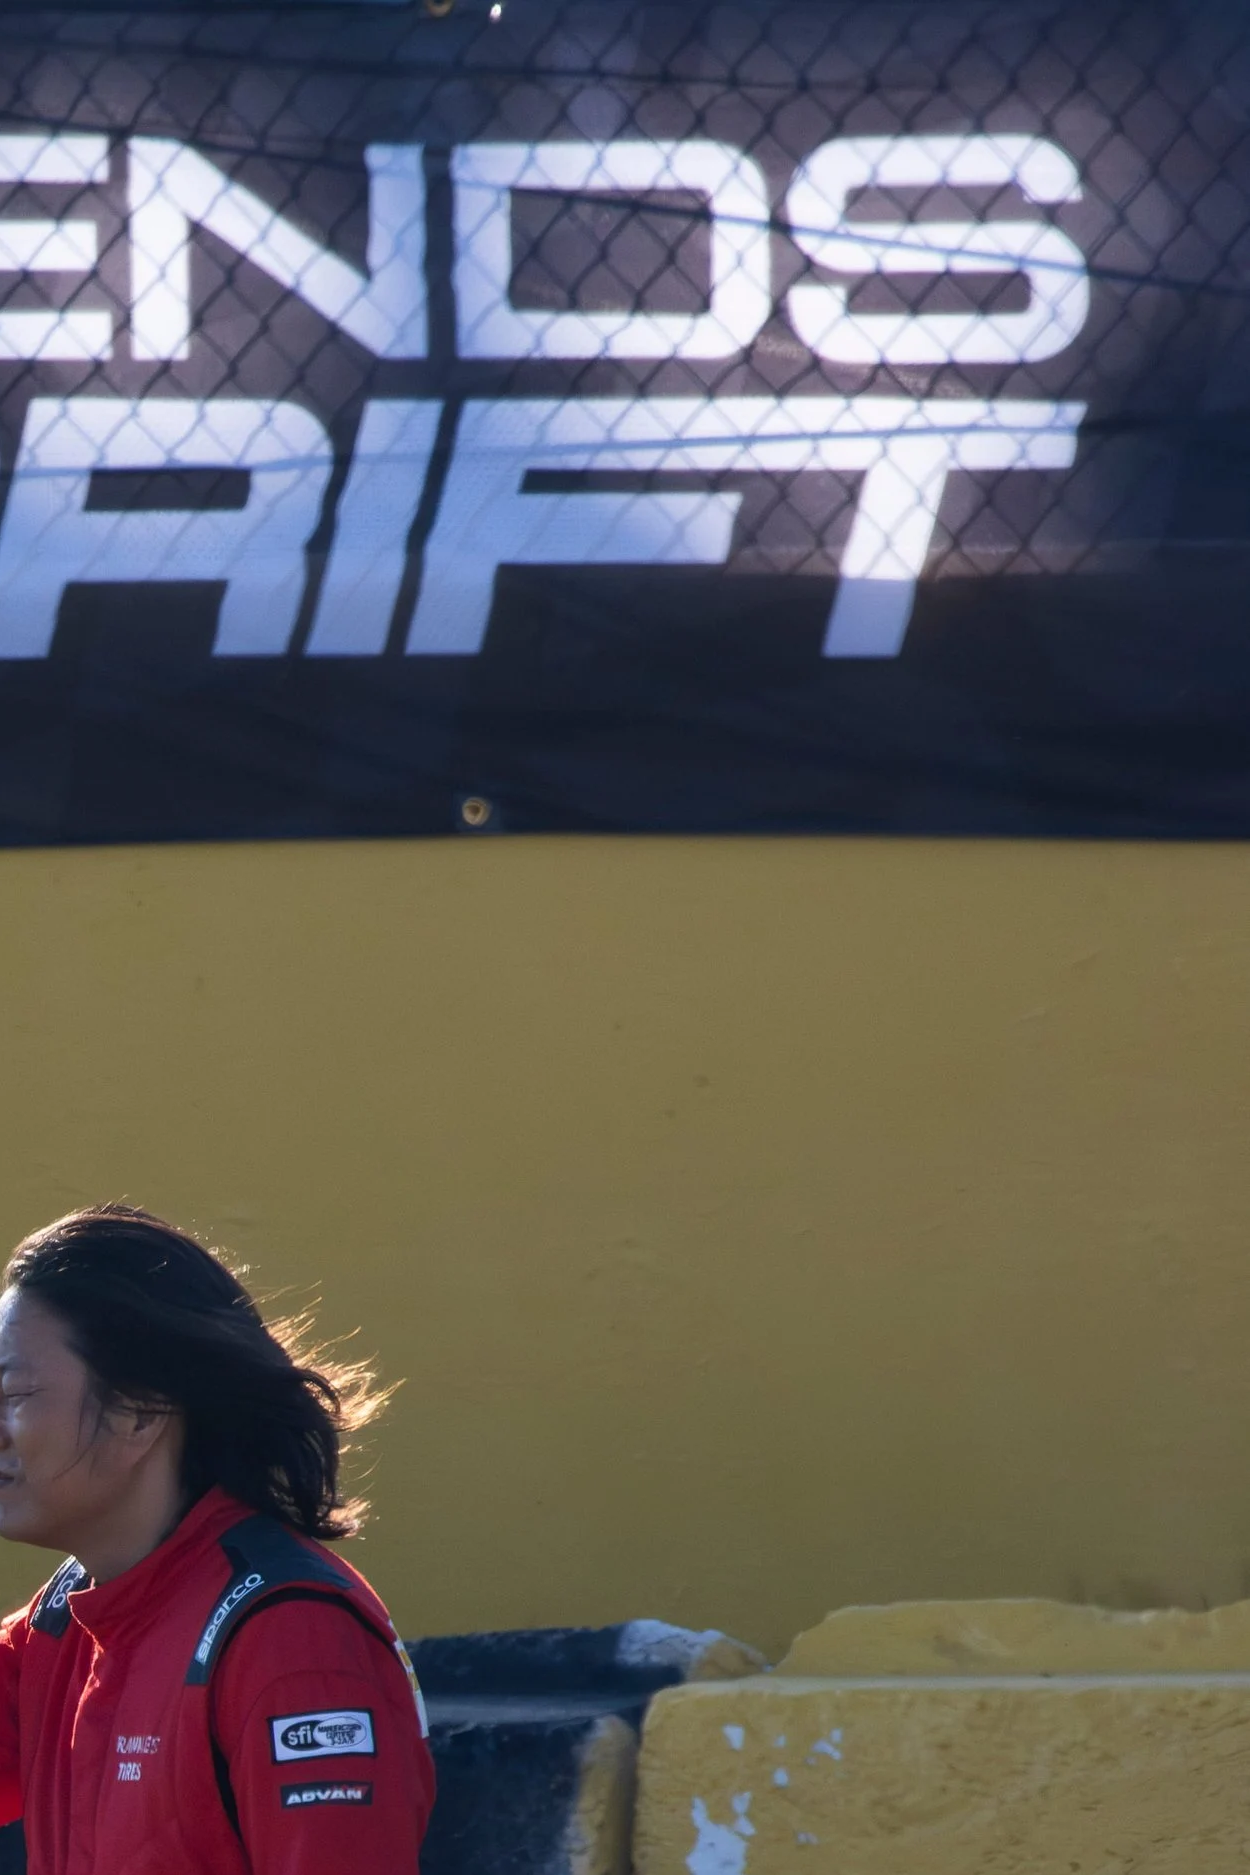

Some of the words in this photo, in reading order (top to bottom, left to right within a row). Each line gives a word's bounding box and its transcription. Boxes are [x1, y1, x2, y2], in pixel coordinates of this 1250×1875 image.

[195, 1573, 265, 1665] sparco
[288, 1725, 312, 1746] sfi
[286, 1788, 363, 1805] ADVAN
